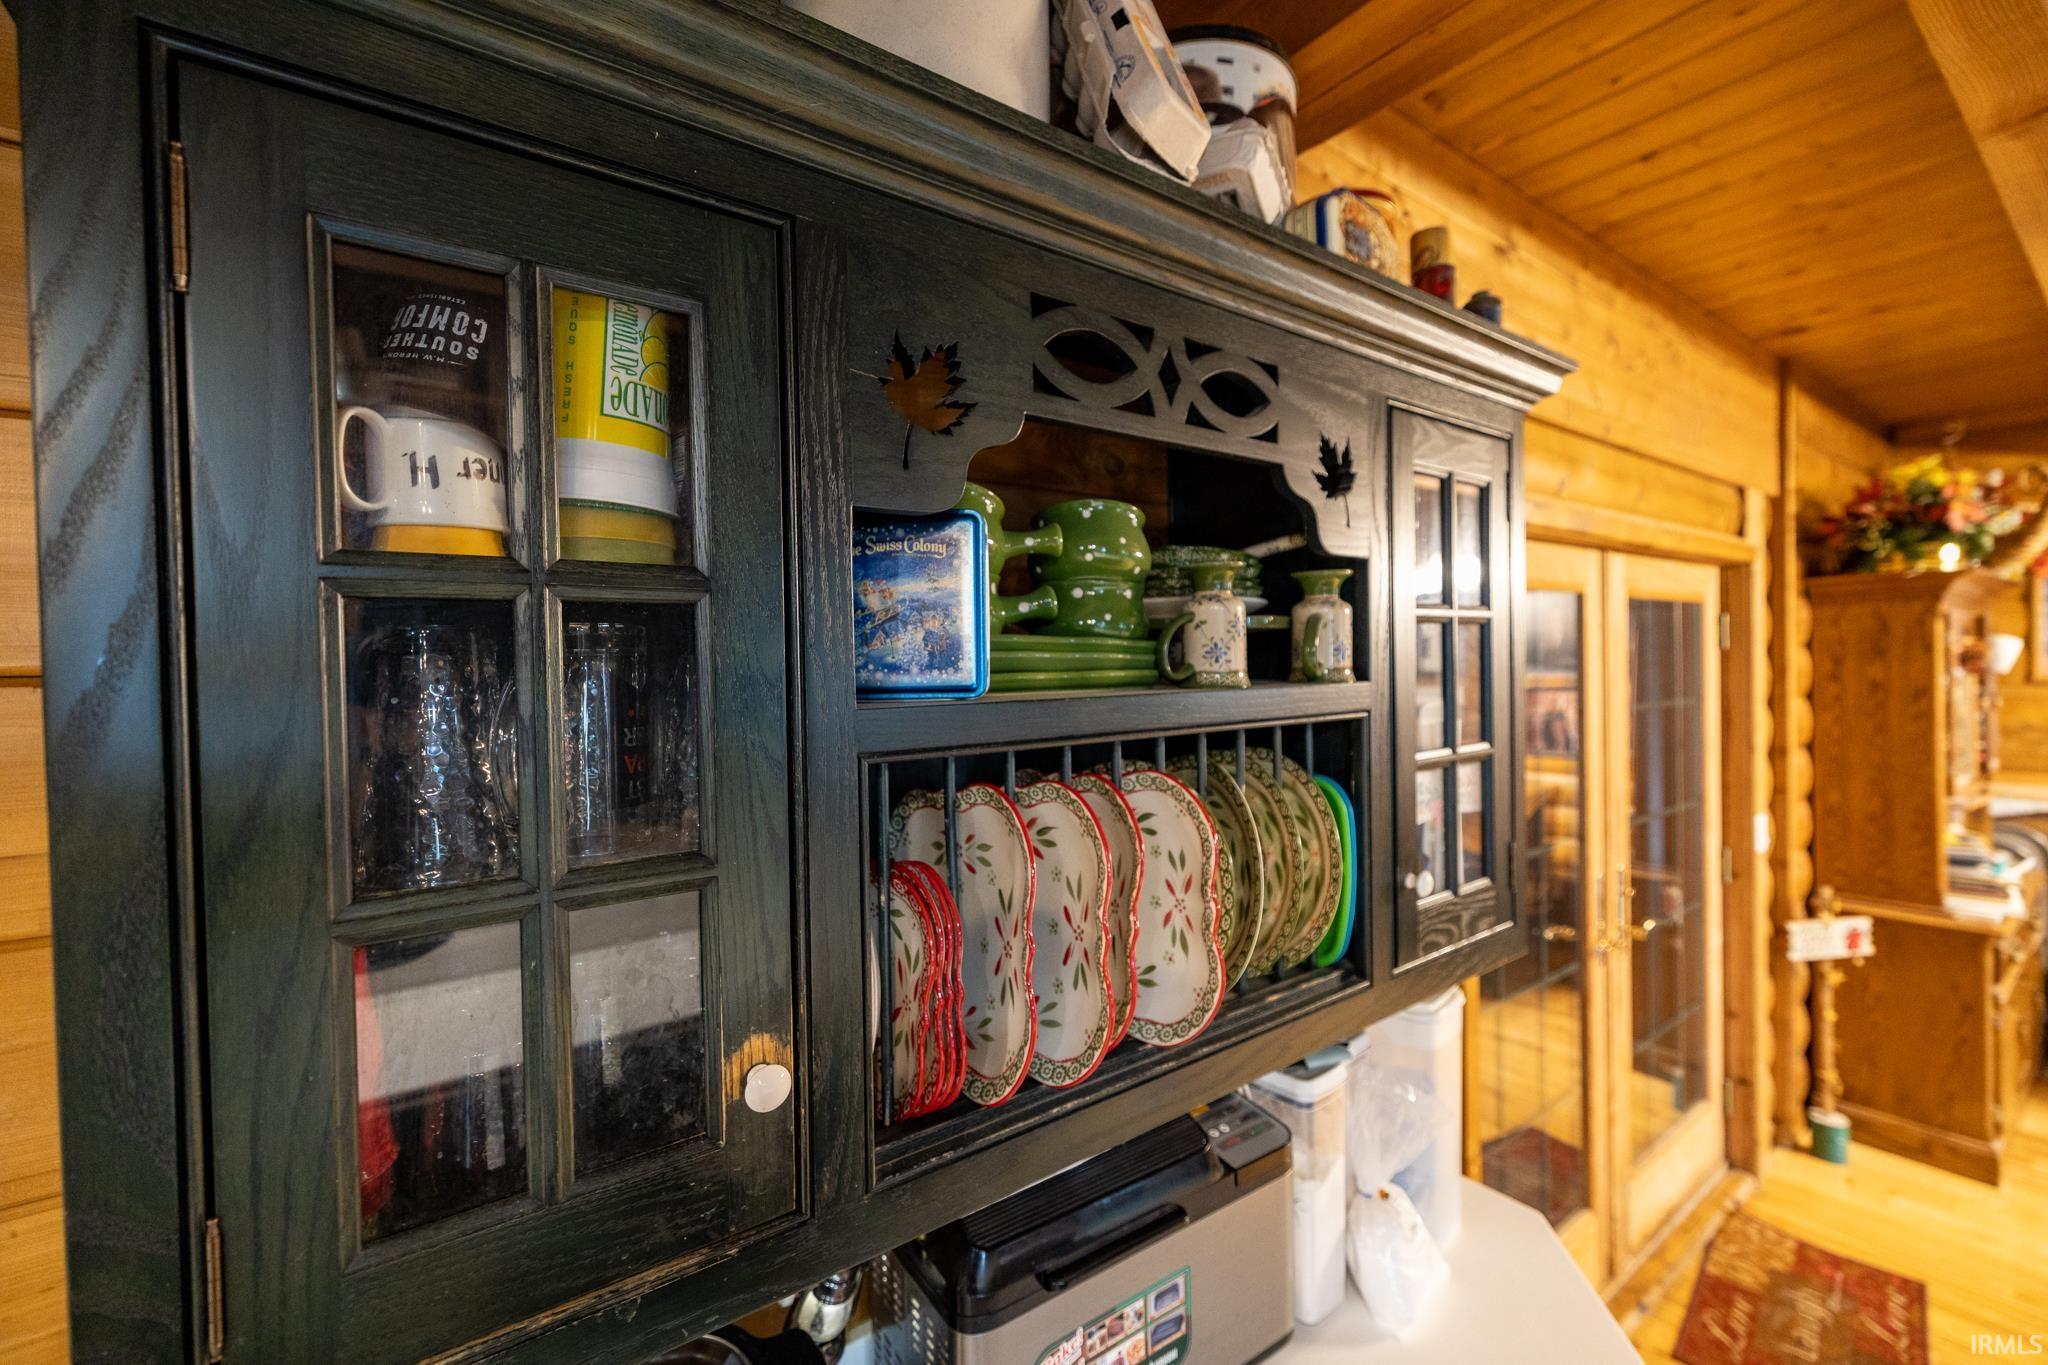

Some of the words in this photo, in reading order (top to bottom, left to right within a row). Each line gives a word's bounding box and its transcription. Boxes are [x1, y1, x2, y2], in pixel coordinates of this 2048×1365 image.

[561, 361, 574, 423] FRESH
[865, 535, 903, 555] Swiss
[904, 534, 948, 559] Colony
